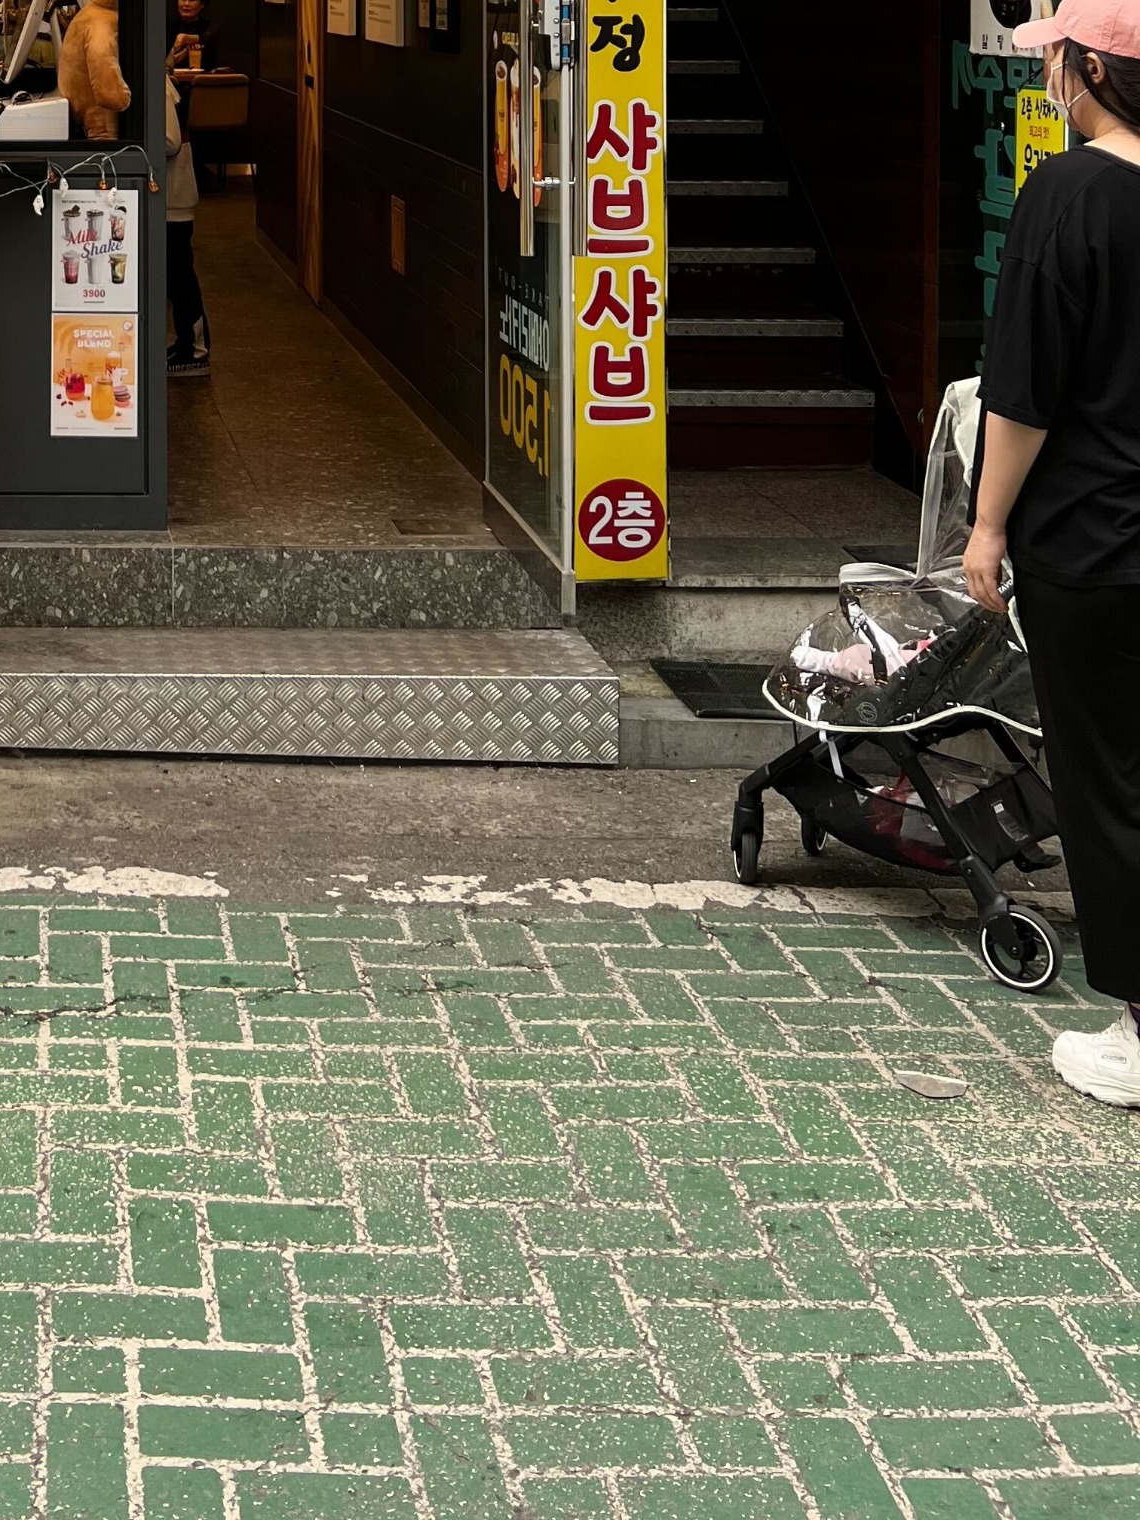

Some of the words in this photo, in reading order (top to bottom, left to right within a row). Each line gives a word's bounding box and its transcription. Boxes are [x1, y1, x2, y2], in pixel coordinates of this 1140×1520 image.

[81, 239, 124, 259] Shake
[580, 100, 660, 423] 샤브샤브
[83, 289, 106, 298] 3900
[73, 329, 114, 339] SPECIAL
[77, 340, 112, 348] BLEND
[587, 491, 657, 549] 2층
